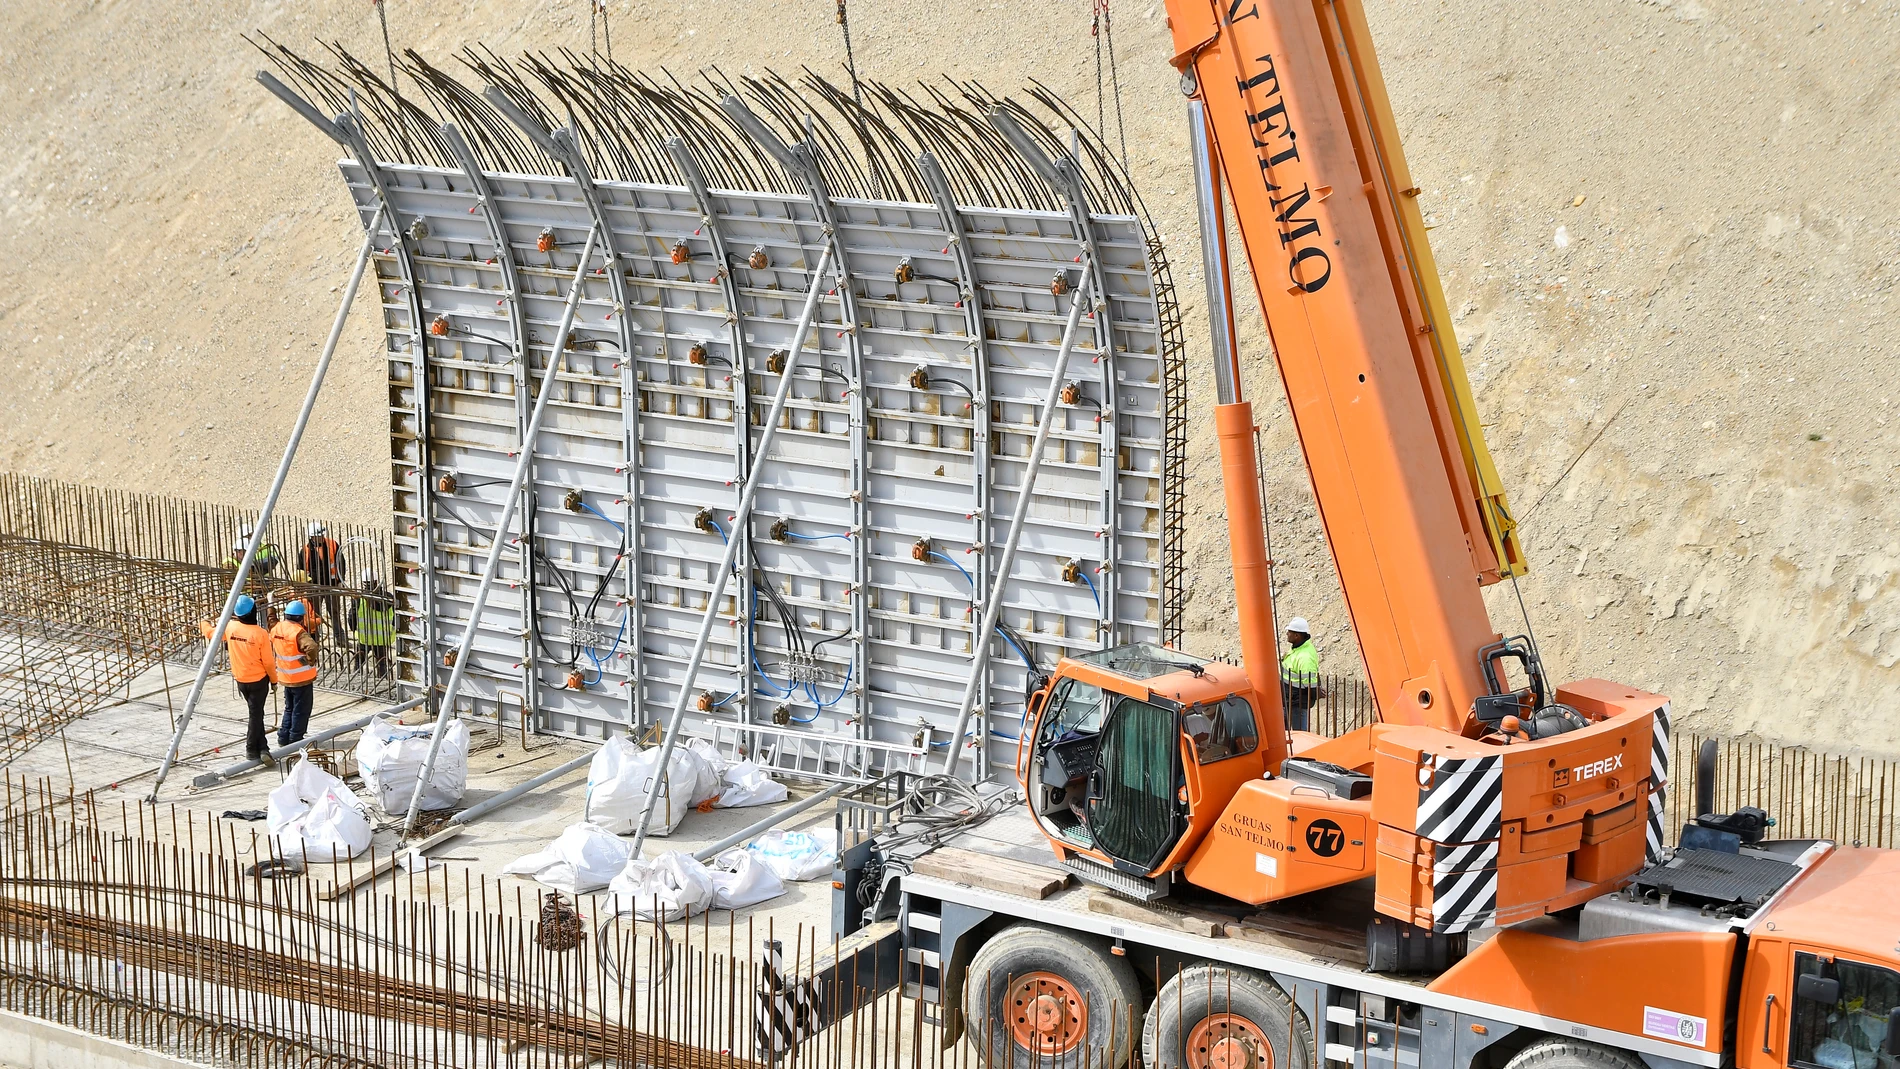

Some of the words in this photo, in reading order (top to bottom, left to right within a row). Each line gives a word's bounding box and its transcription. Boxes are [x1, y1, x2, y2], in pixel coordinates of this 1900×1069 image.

[1235, 53, 1332, 294] TELMO
[1573, 753, 1623, 781] TEREX
[1220, 822, 1242, 838] SAN
[1244, 830, 1285, 852] TELMO
[1233, 812, 1272, 834] GRUAS
[1309, 826, 1342, 851] 77
